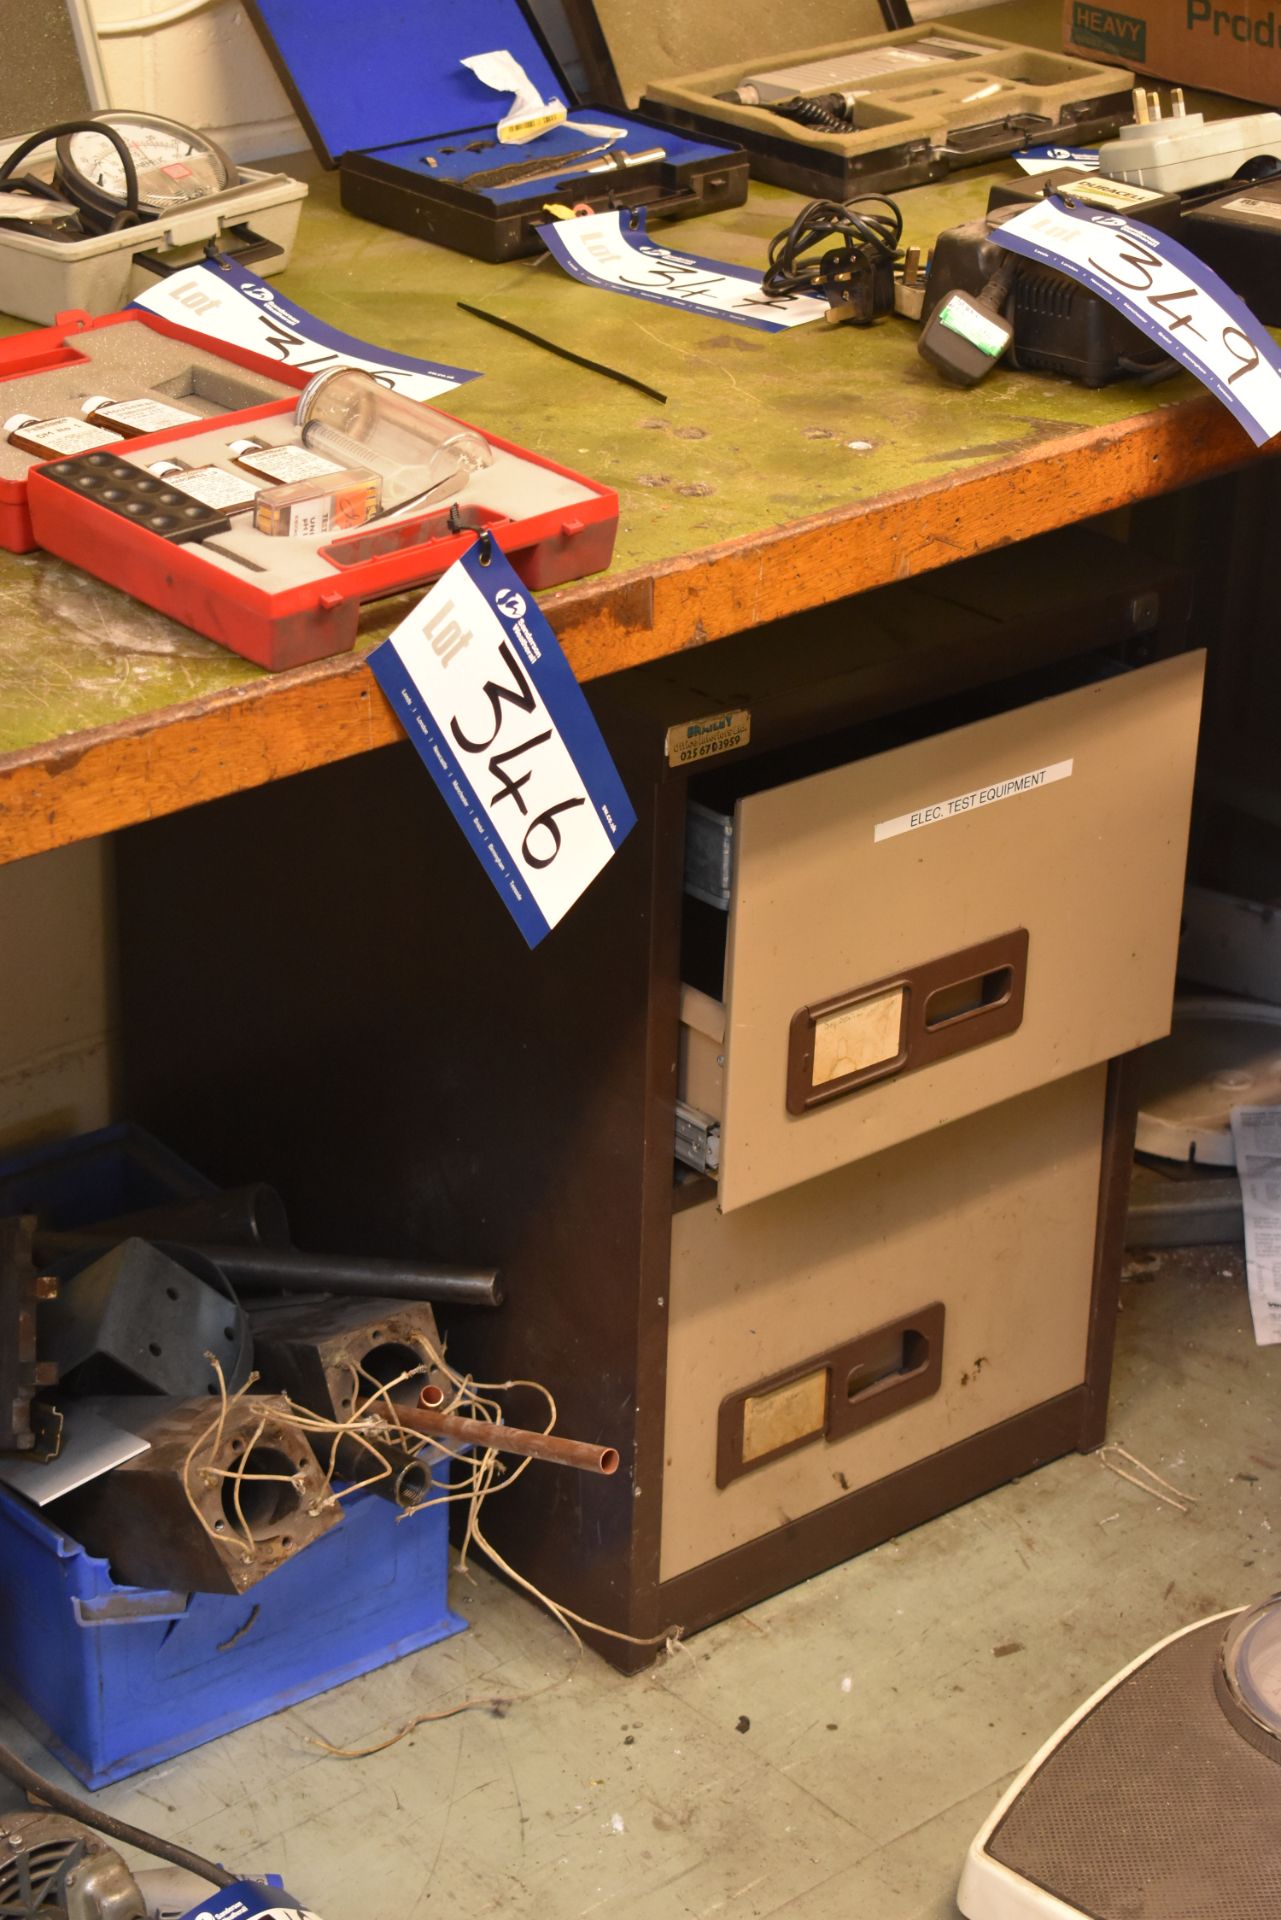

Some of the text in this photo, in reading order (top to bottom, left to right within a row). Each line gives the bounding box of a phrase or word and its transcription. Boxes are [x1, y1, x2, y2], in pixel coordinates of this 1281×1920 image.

[1077, 6, 1141, 42] HEAVY
[1187, 0, 1281, 48] Prod
[1078, 180, 1148, 201] DURACELL
[168, 280, 222, 317] Lot
[1088, 235, 1260, 385] 349
[423, 599, 474, 669] Lot
[450, 640, 586, 869] 346
[910, 770, 1048, 828] ELEC. TEST EQUIPMENT
